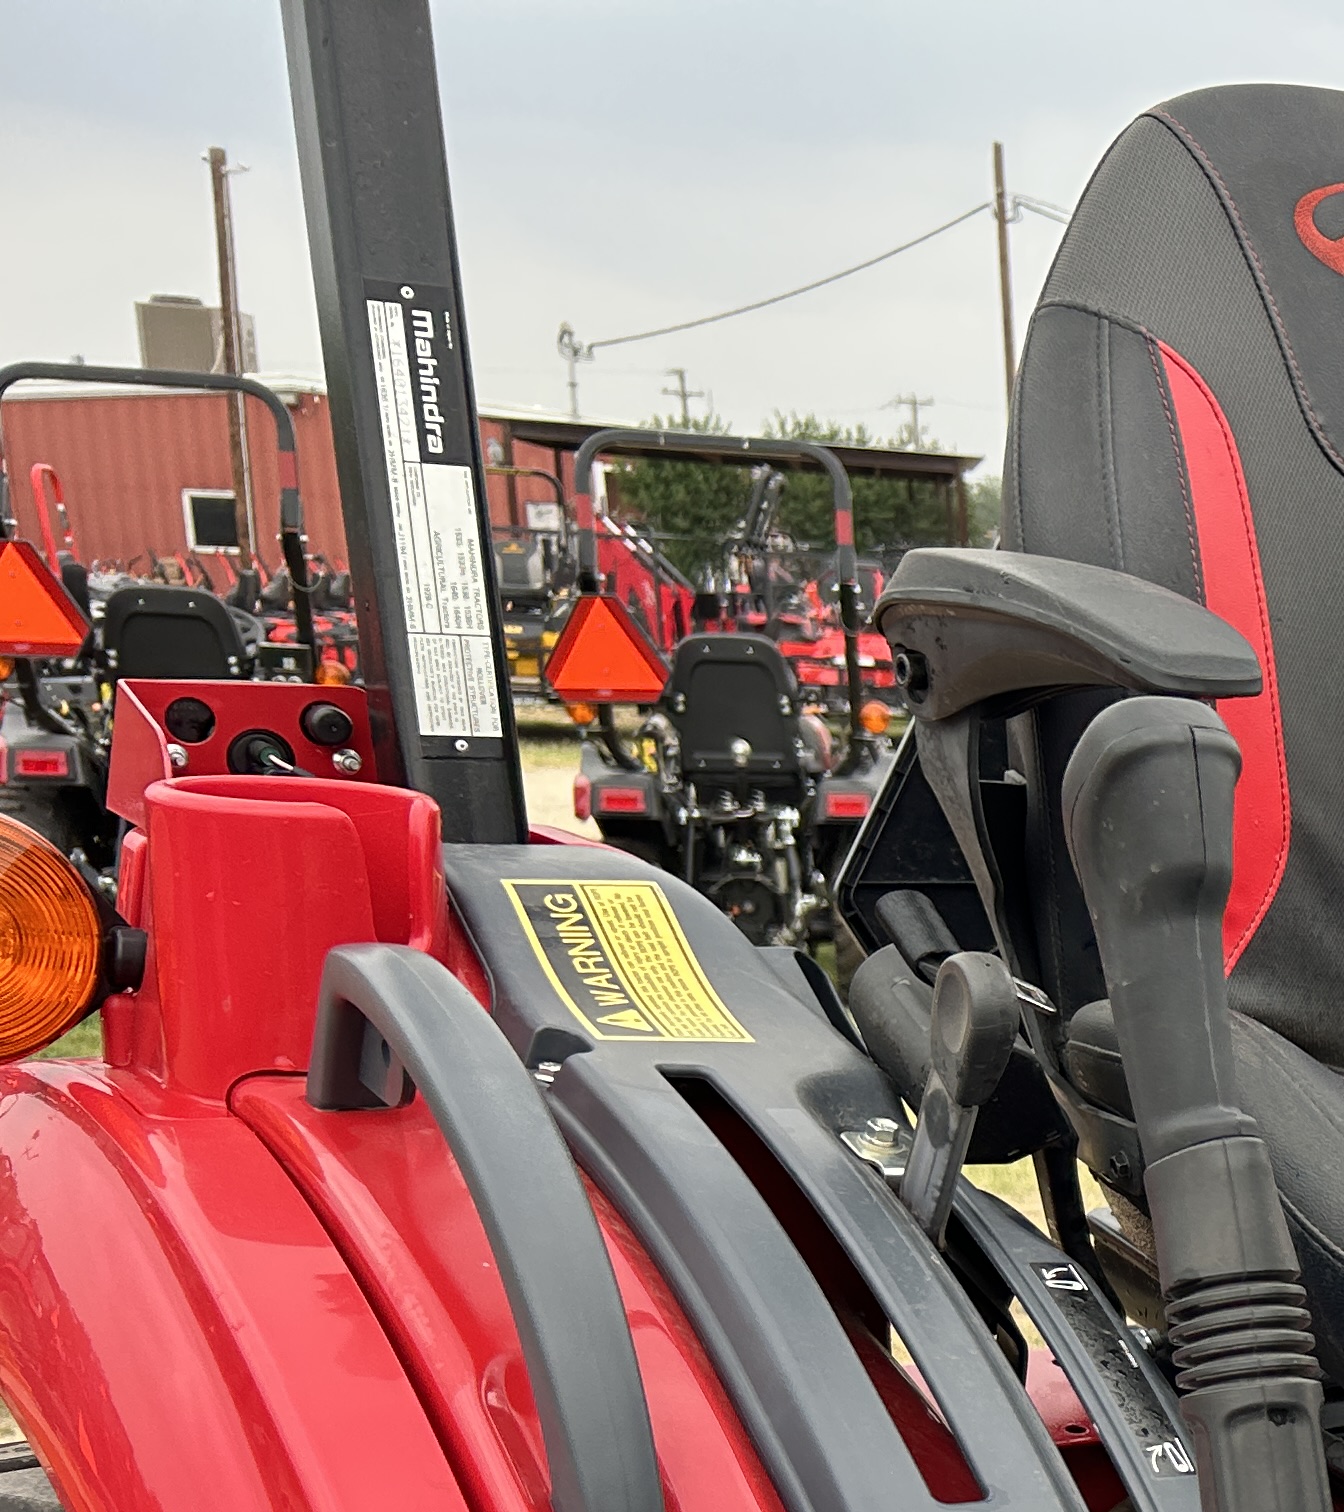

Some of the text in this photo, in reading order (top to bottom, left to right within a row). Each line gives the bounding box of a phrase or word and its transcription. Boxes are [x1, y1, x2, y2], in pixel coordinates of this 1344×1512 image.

[412, 310, 443, 452] Mahindra
[467, 538, 484, 630] MAHINDRA TRACTORS
[544, 893, 631, 1007] WARNING
